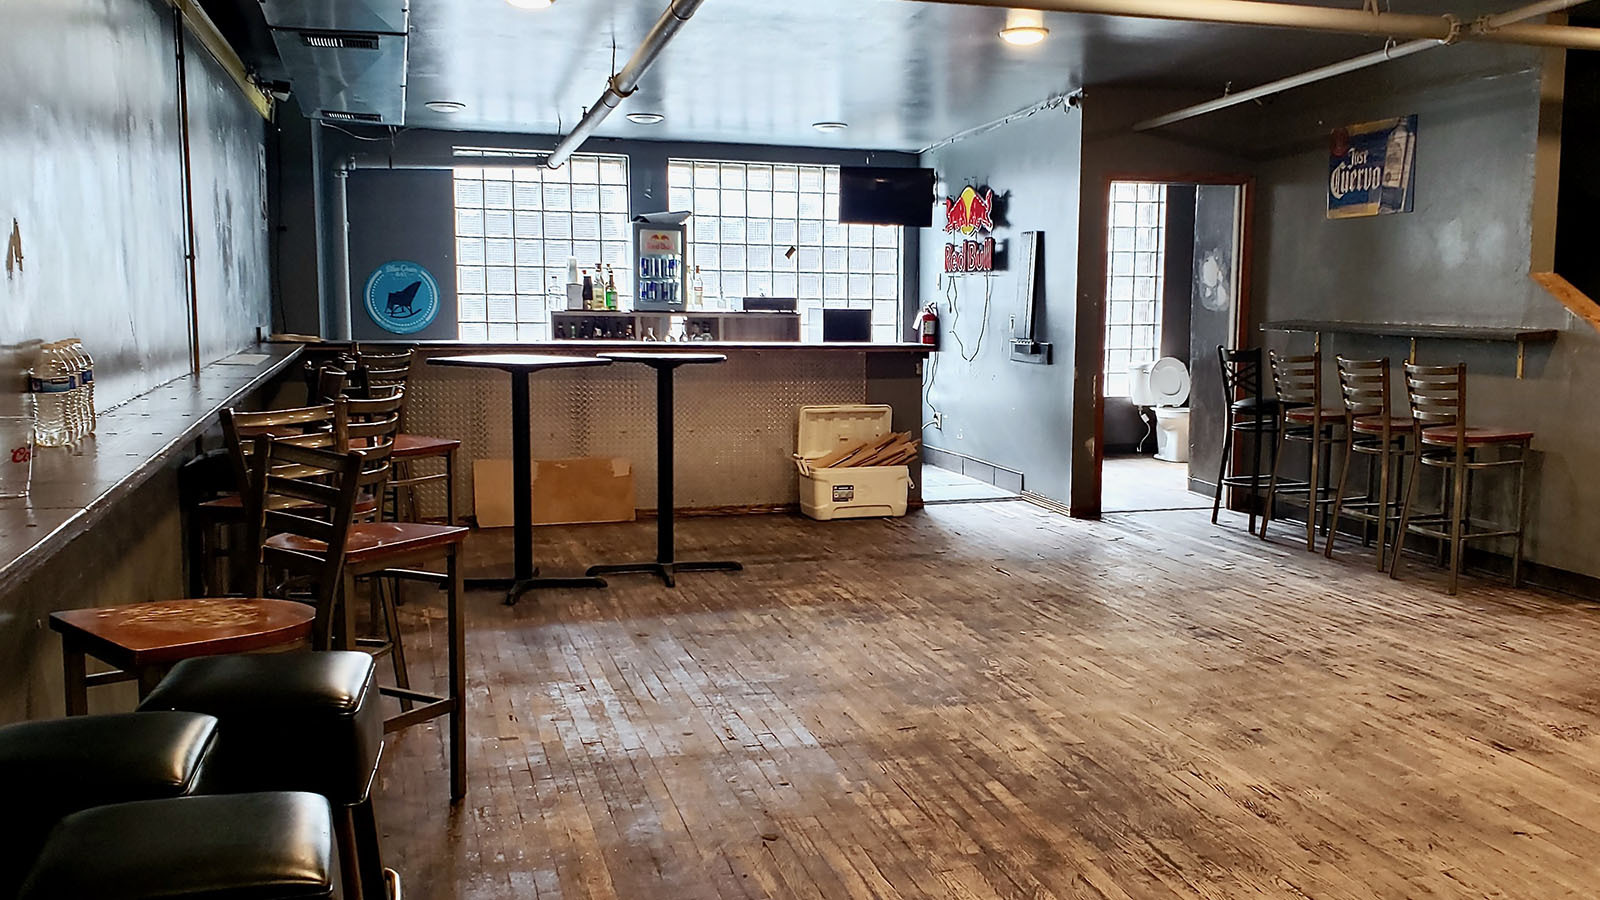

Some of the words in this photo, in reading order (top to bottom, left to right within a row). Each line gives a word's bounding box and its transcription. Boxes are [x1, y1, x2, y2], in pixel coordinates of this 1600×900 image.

[1330, 161, 1381, 199] Cuervo
[945, 239, 967, 273] Red
[967, 238, 992, 272] Bull
